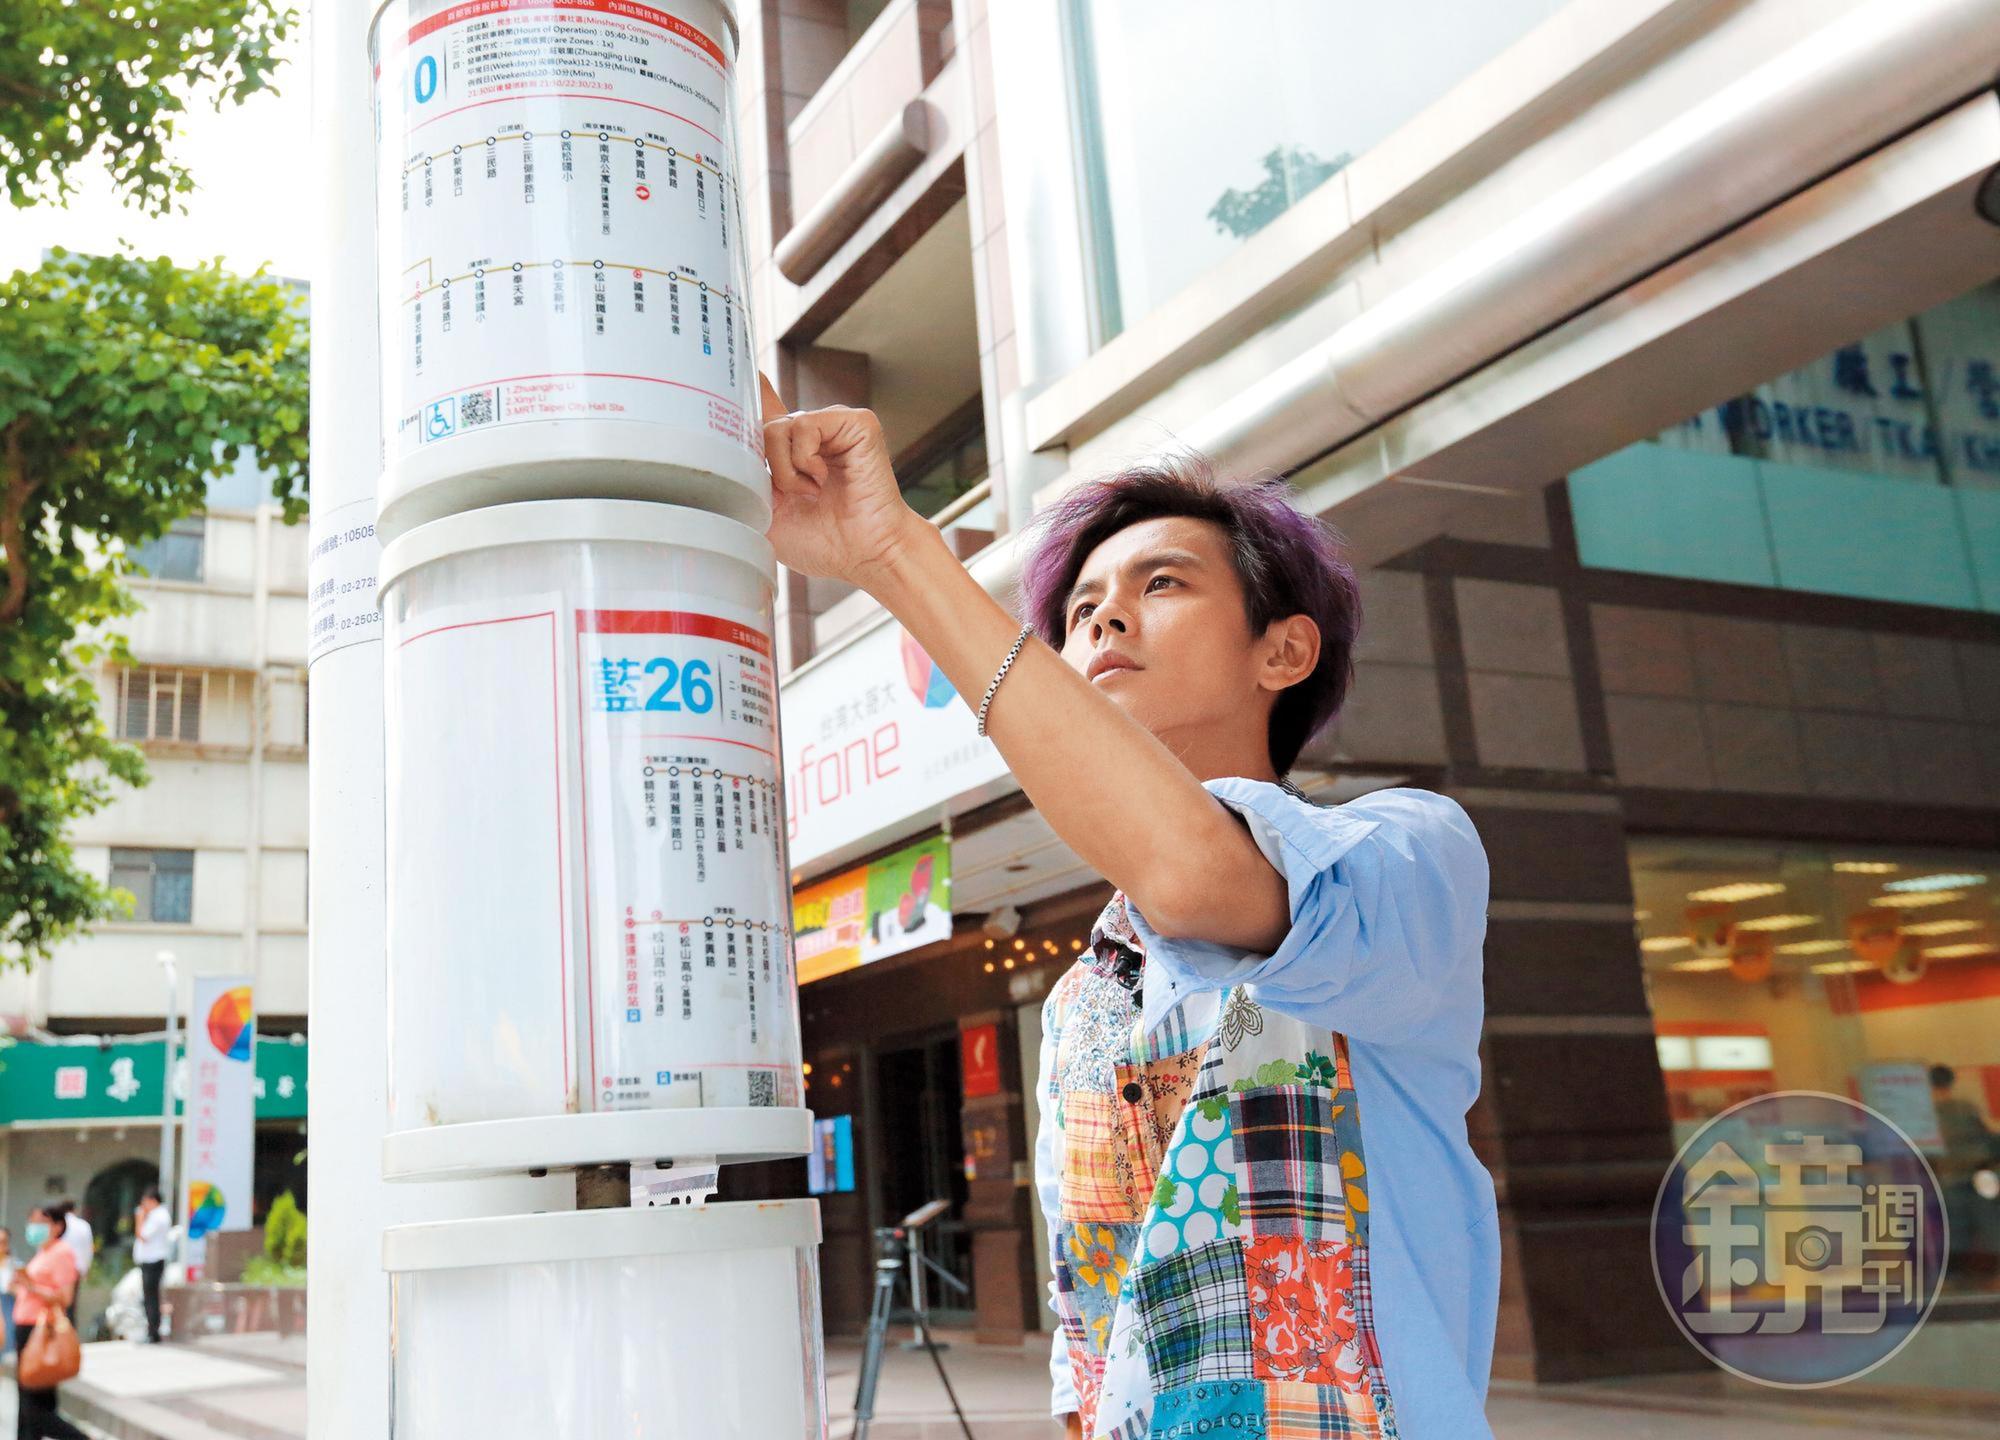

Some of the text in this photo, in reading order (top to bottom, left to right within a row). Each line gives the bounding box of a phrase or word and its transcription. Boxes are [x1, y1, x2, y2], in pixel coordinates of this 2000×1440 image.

[591, 657, 714, 714] 藍26
[714, 784, 726, 853] 內湖運動公園
[625, 932, 638, 1007] 捷運市政府站
[679, 936, 692, 1020] 松山高中(基隆路)
[704, 931, 715, 968] 東興路
